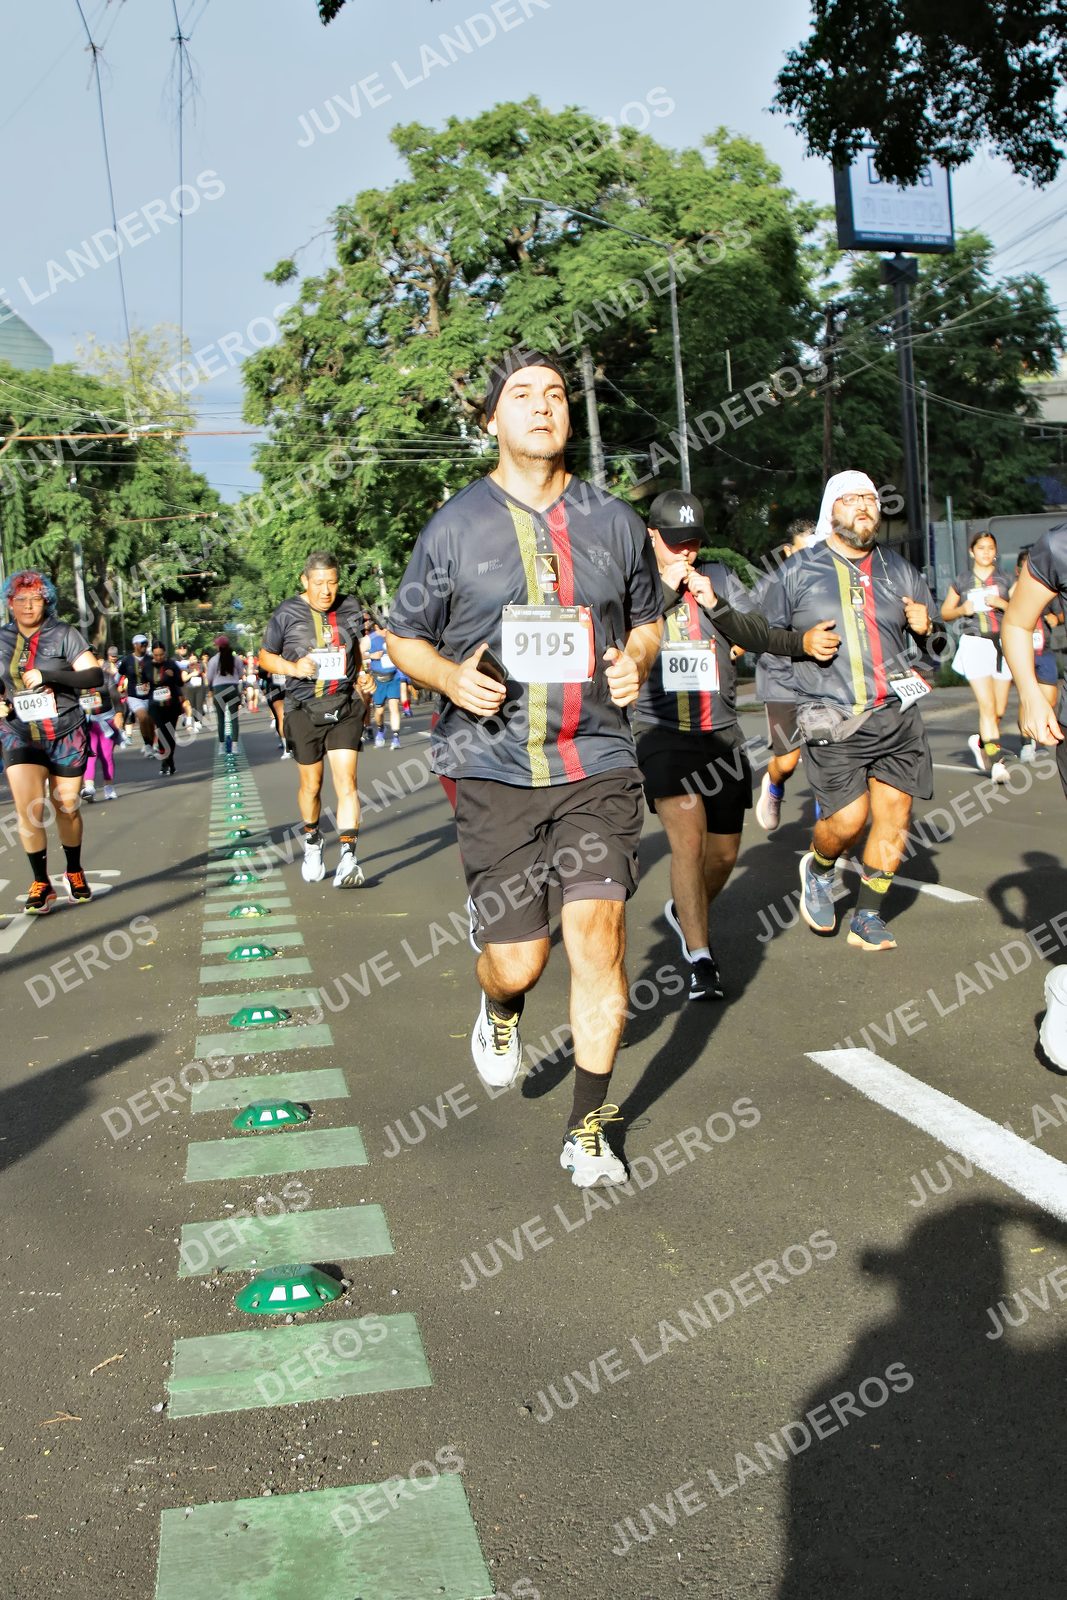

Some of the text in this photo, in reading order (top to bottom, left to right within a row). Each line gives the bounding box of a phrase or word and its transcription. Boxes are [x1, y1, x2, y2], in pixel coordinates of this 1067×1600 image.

[515, 632, 575, 656] 9195
[669, 657, 709, 674] 8076
[17, 697, 49, 711] 10493
